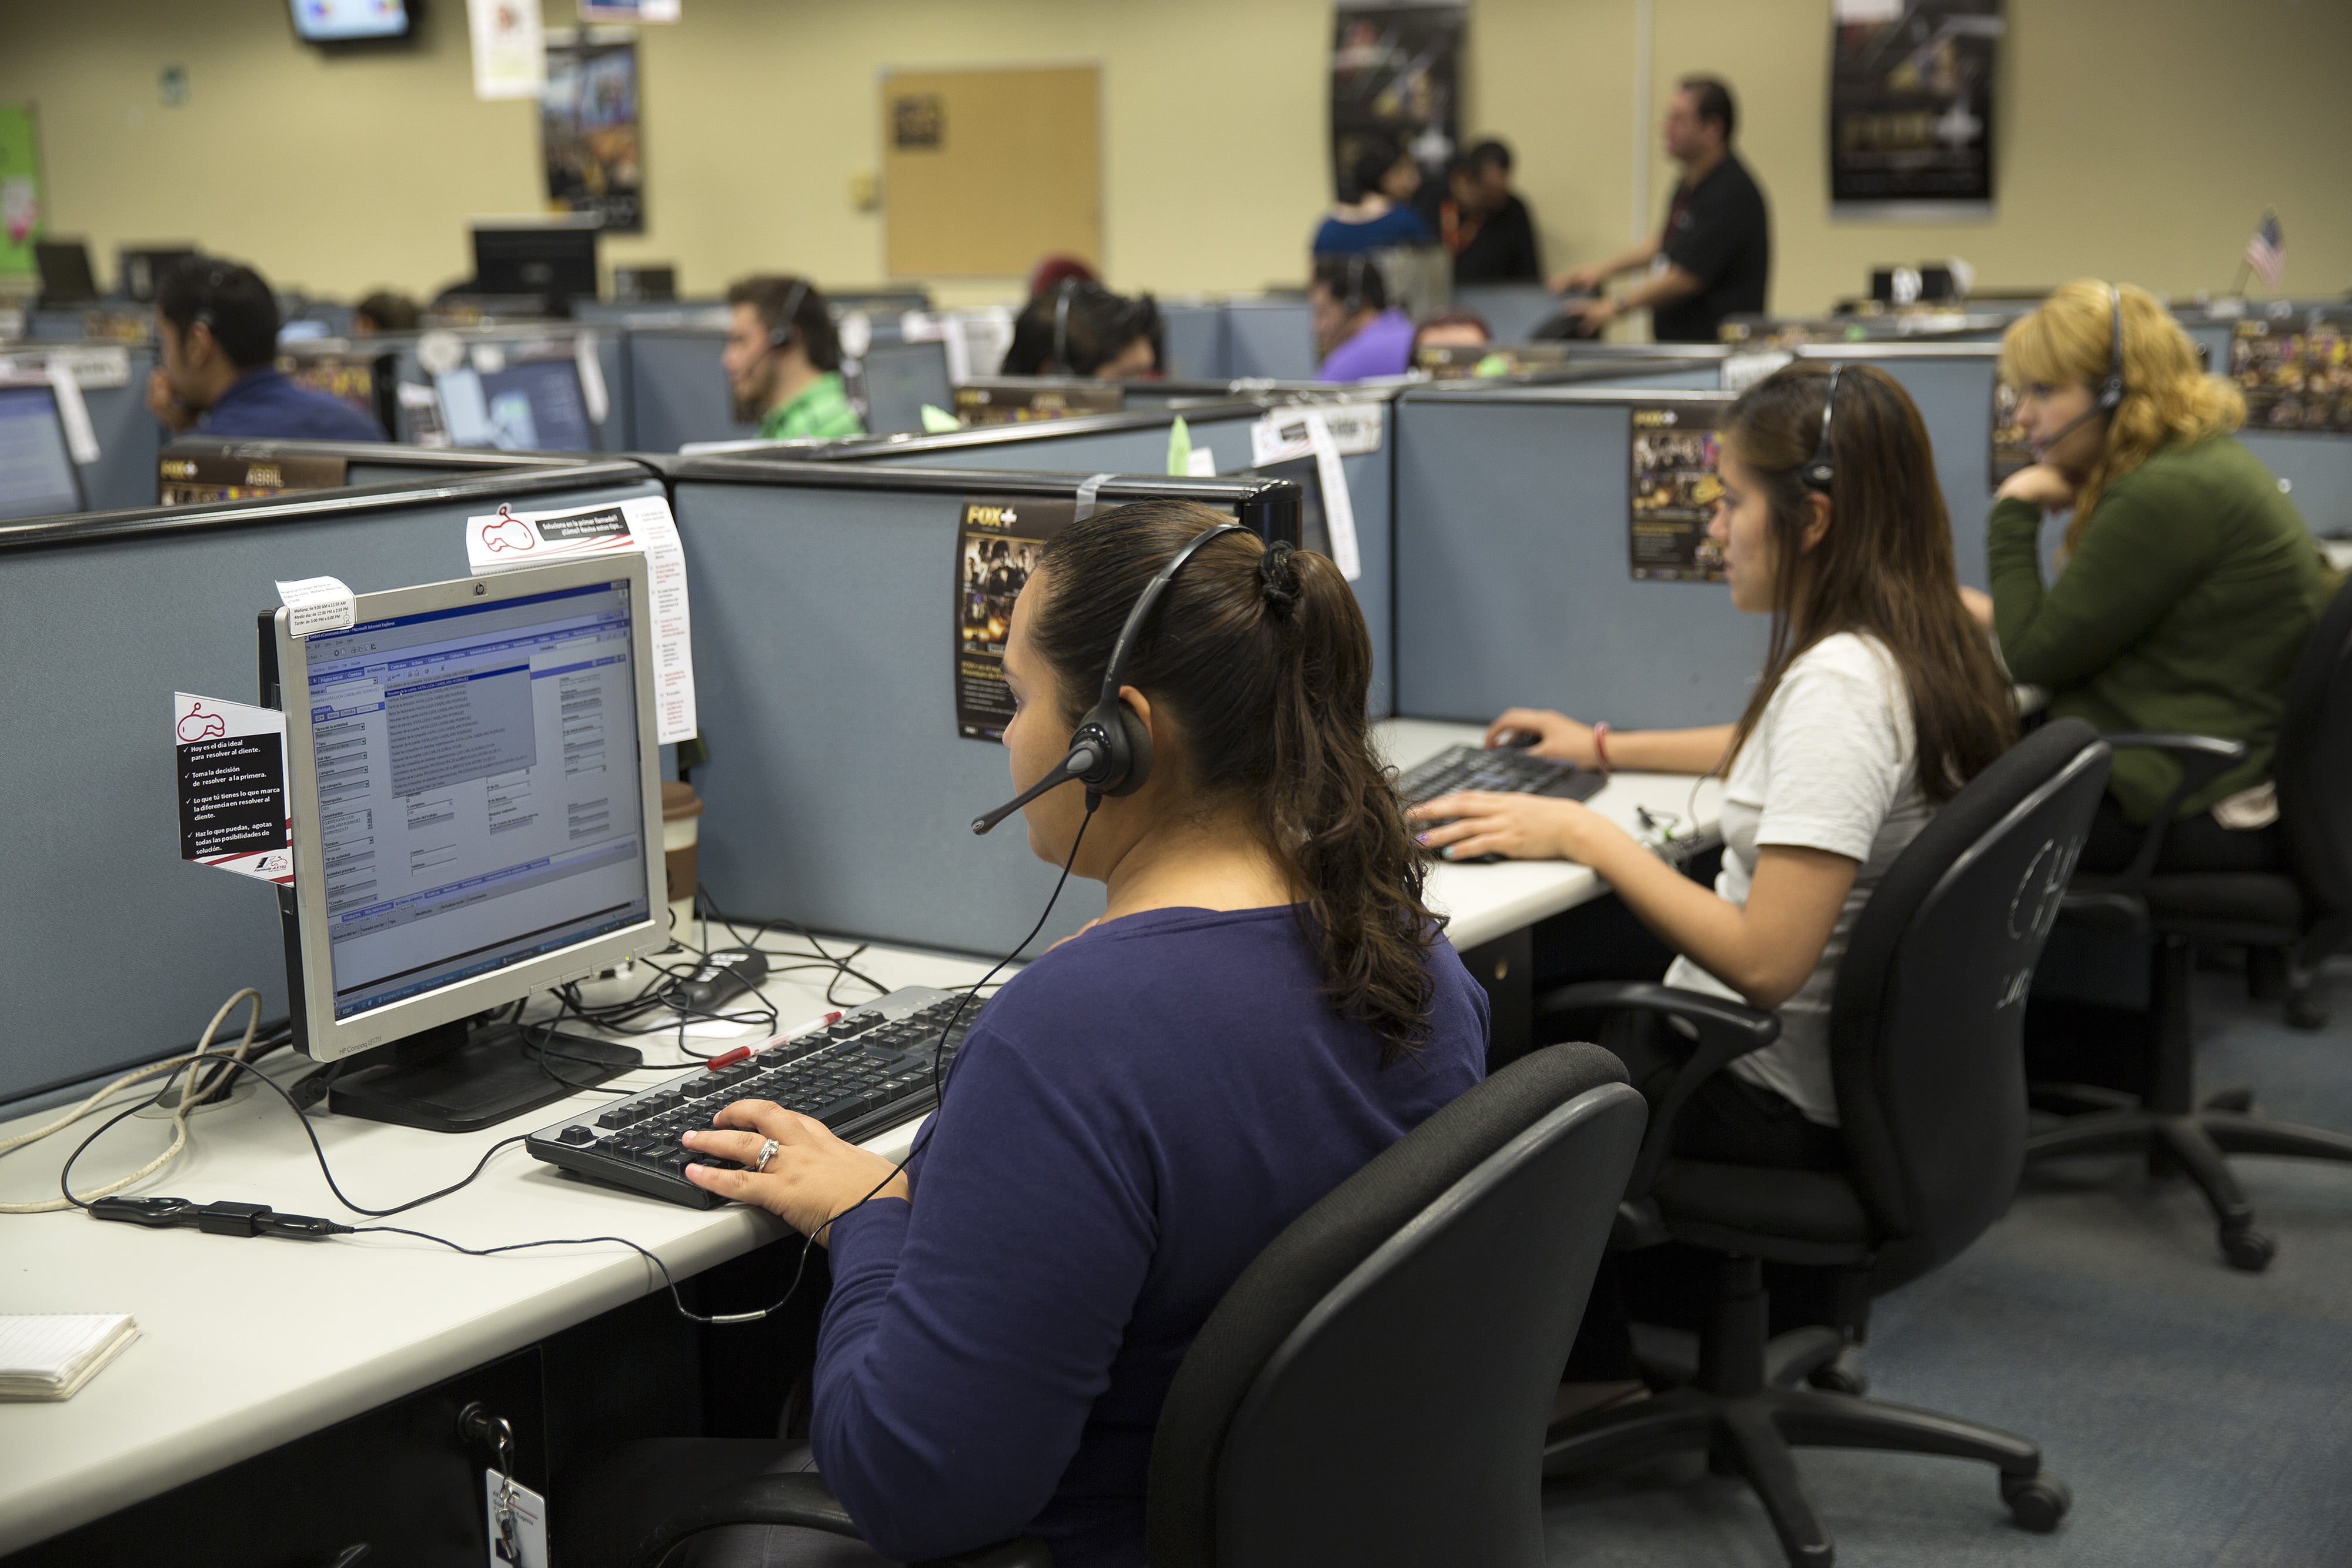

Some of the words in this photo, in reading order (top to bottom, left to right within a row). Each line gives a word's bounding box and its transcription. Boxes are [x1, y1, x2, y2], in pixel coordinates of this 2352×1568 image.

[967, 504, 1018, 528] FOX+
[313, 706, 330, 714] Actividad
[206, 751, 230, 759] resolver
[215, 766, 240, 774] decisión
[202, 777, 226, 785] resolver
[240, 773, 266, 781] primera.
[200, 803, 229, 811] diferencia
[194, 813, 215, 821] cliente.
[226, 825, 250, 833] puedas,
[252, 821, 272, 830] agotas
[196, 838, 212, 846] todas
[222, 830, 261, 842] posibilidades
[196, 846, 222, 855] solución.
[342, 1007, 353, 1015] start
[347, 1043, 368, 1052] Compaq
[368, 1036, 382, 1045] LE1711
[516, 1512, 533, 1526] Eugenia
